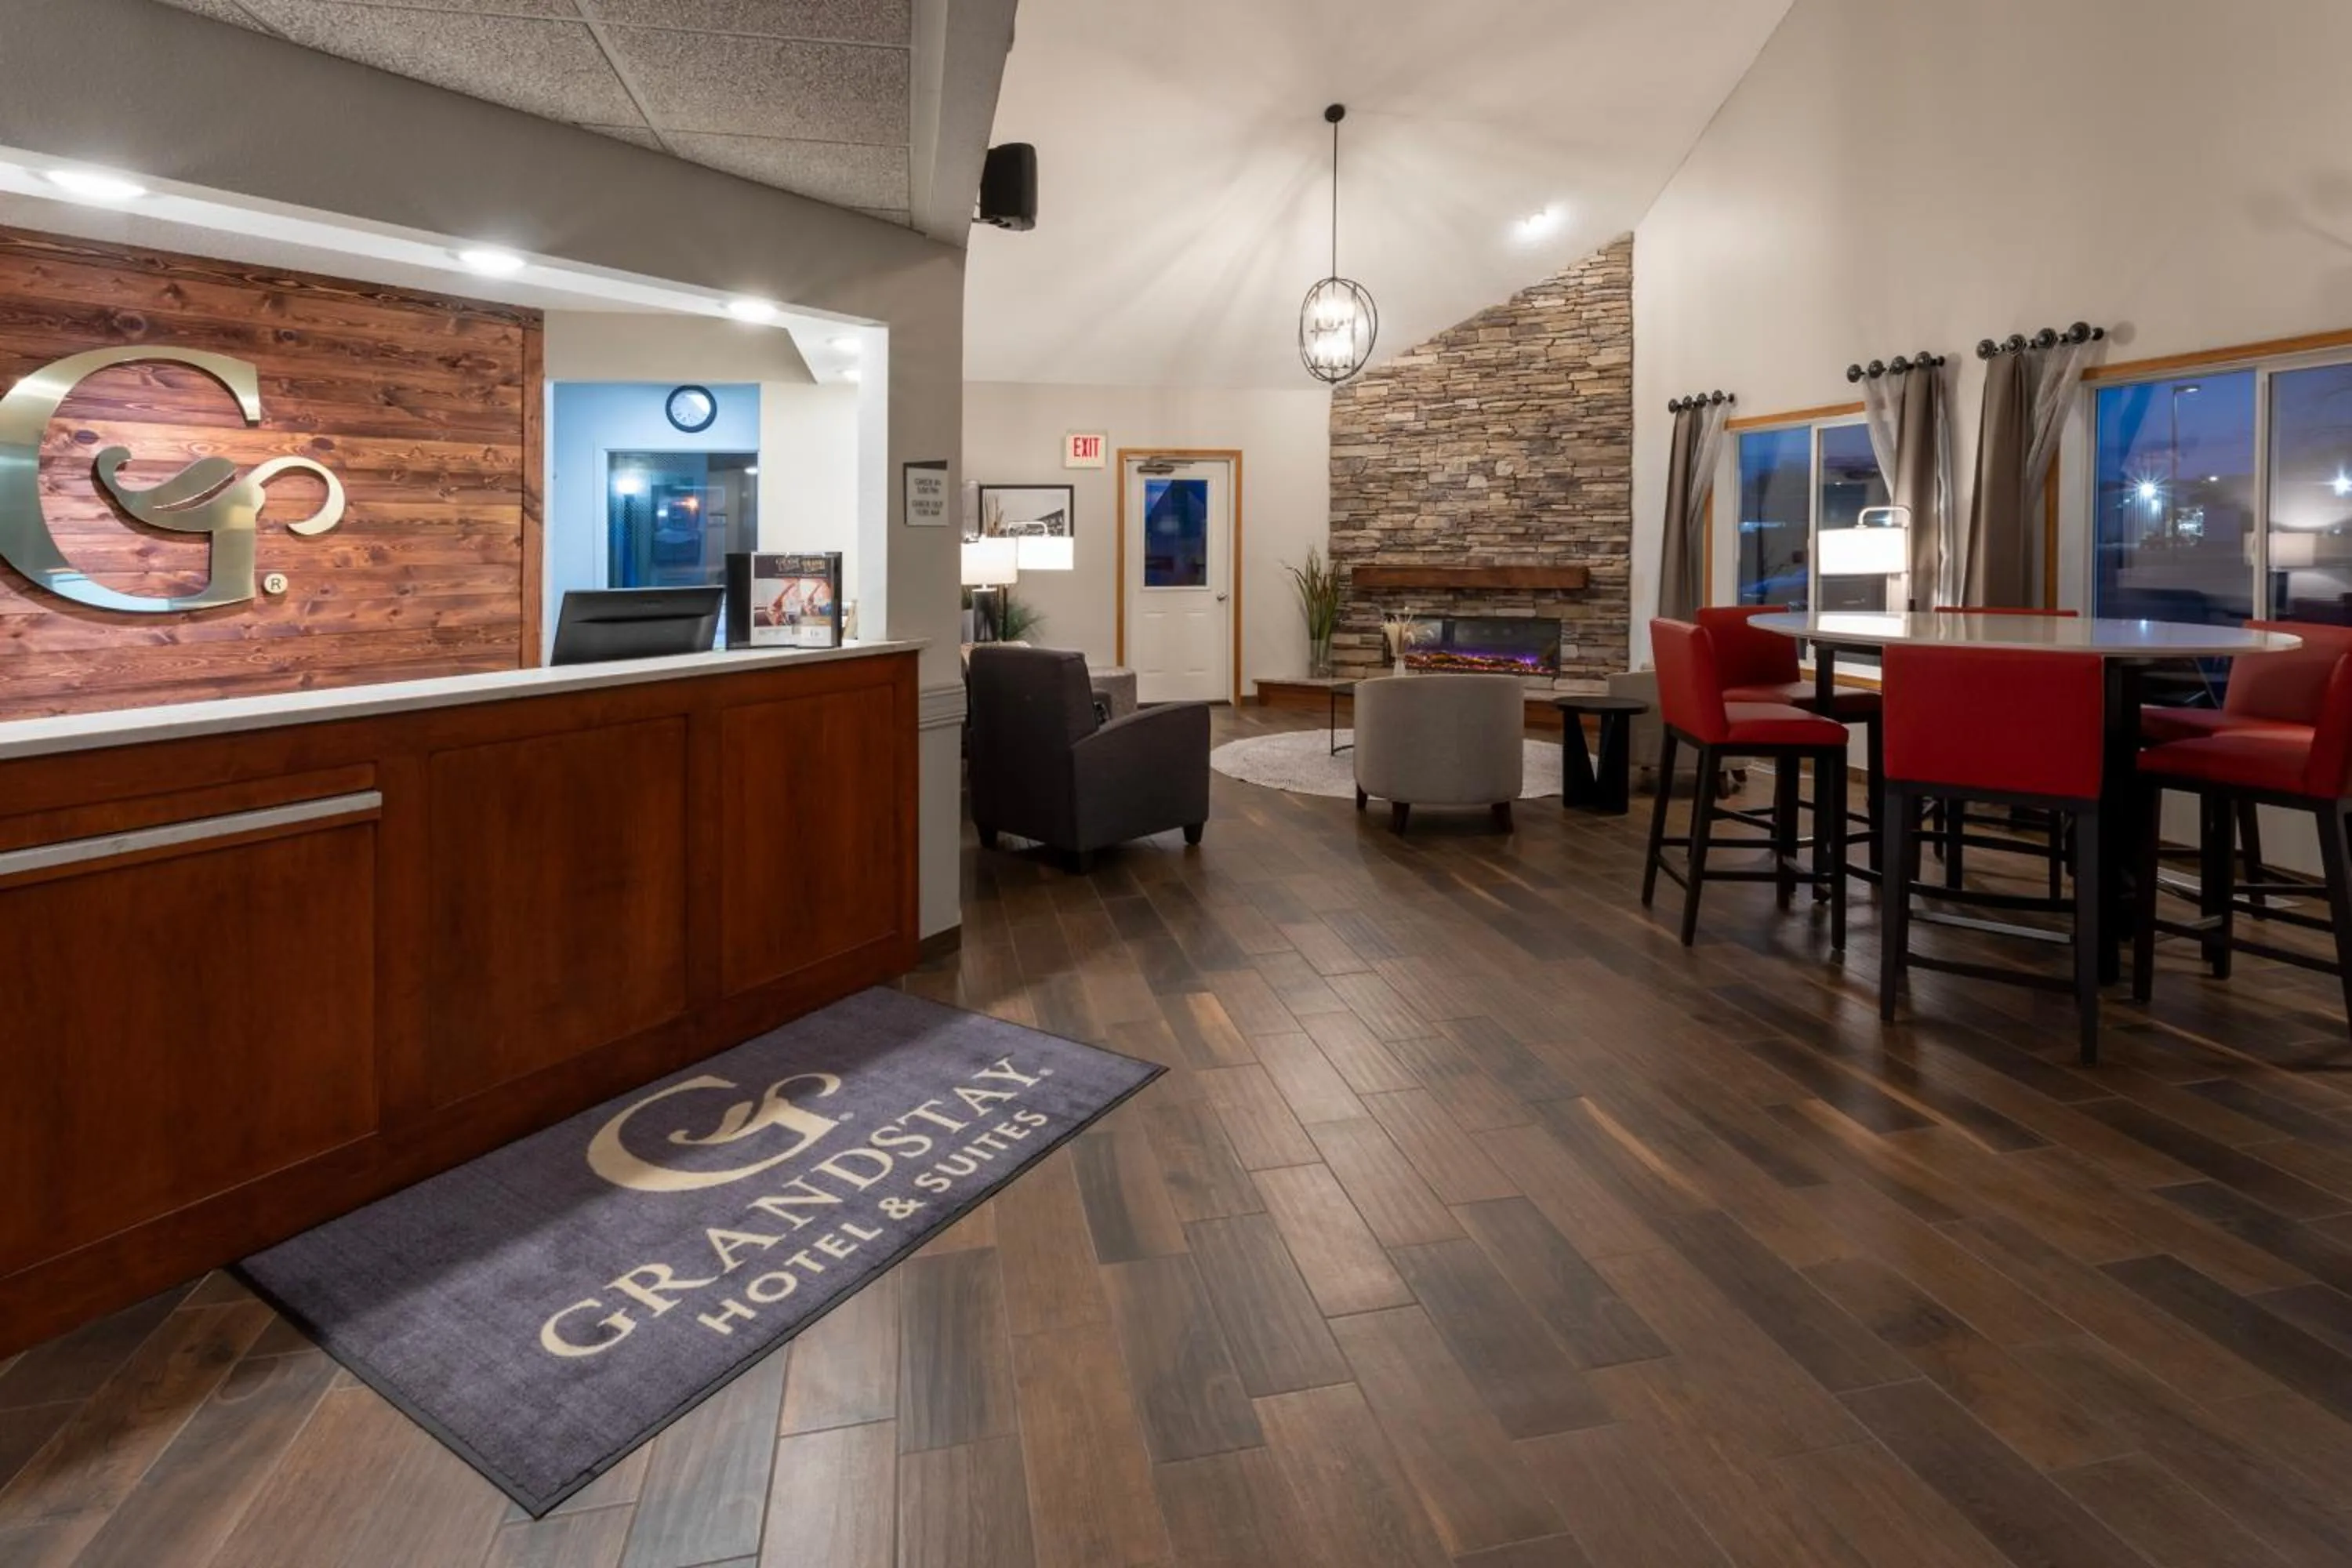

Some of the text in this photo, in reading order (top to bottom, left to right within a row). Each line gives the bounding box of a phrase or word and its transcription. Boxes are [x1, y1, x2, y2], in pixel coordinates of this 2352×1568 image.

[1073, 437, 1100, 458] EXIT
[540, 1057, 1041, 1357] GRANDSTAY
[697, 1109, 1048, 1334] HOTEL & SUITES
